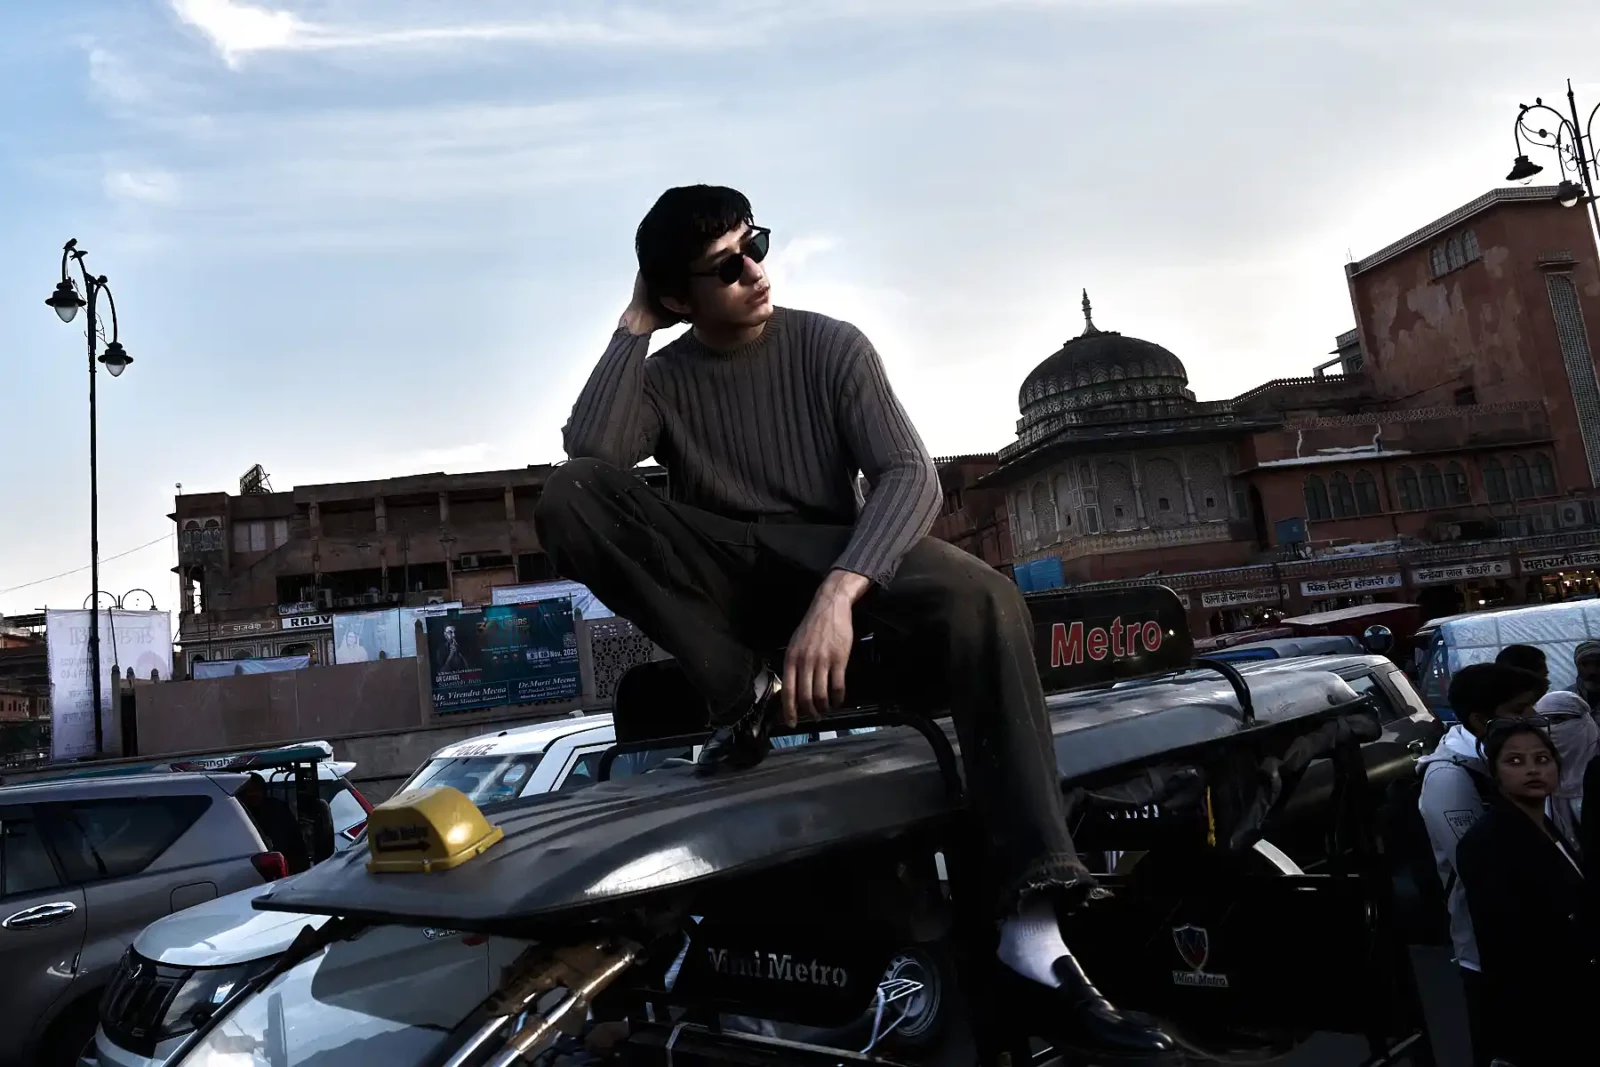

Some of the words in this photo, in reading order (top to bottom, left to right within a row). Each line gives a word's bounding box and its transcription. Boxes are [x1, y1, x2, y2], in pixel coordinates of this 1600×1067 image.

[1446, 568, 1462, 578] लाल
[1051, 616, 1162, 667] Metro
[448, 690, 480, 699] Virendra
[482, 687, 506, 695] Meena
[452, 743, 497, 756] POLICE
[768, 953, 848, 988] Metro
[1199, 975, 1226, 985] Metro
